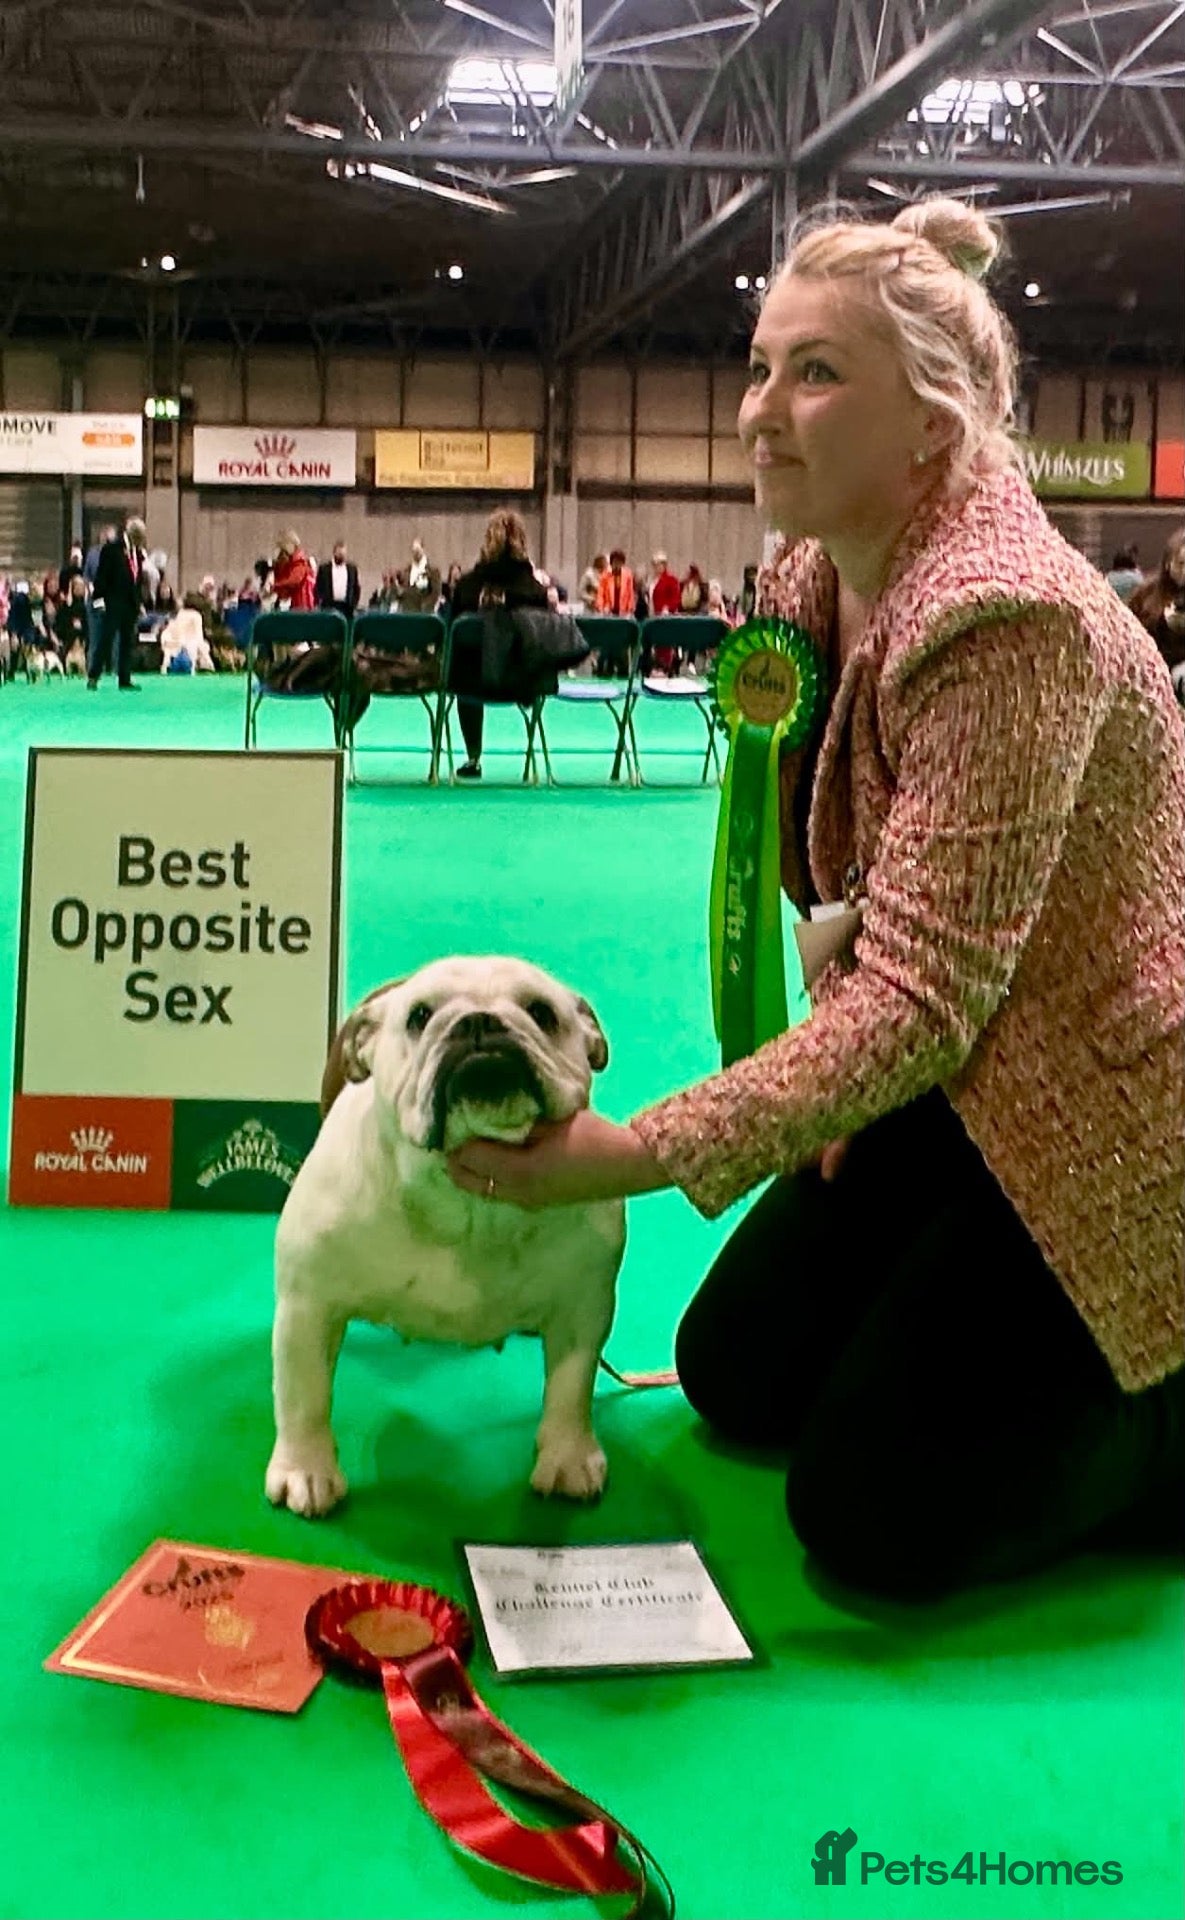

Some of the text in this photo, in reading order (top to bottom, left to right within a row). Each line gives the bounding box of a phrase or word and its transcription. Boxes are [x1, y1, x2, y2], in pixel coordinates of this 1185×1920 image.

[218, 460, 331, 479] ROYAL CANIN
[117, 836, 251, 888] Best
[51, 897, 312, 964] Opposite
[123, 970, 233, 1026] Sex
[35, 1152, 147, 1173] ROYAL CANIN
[534, 1576, 655, 1595] Kennel Club
[496, 1591, 703, 1613] Challenge Certificate
